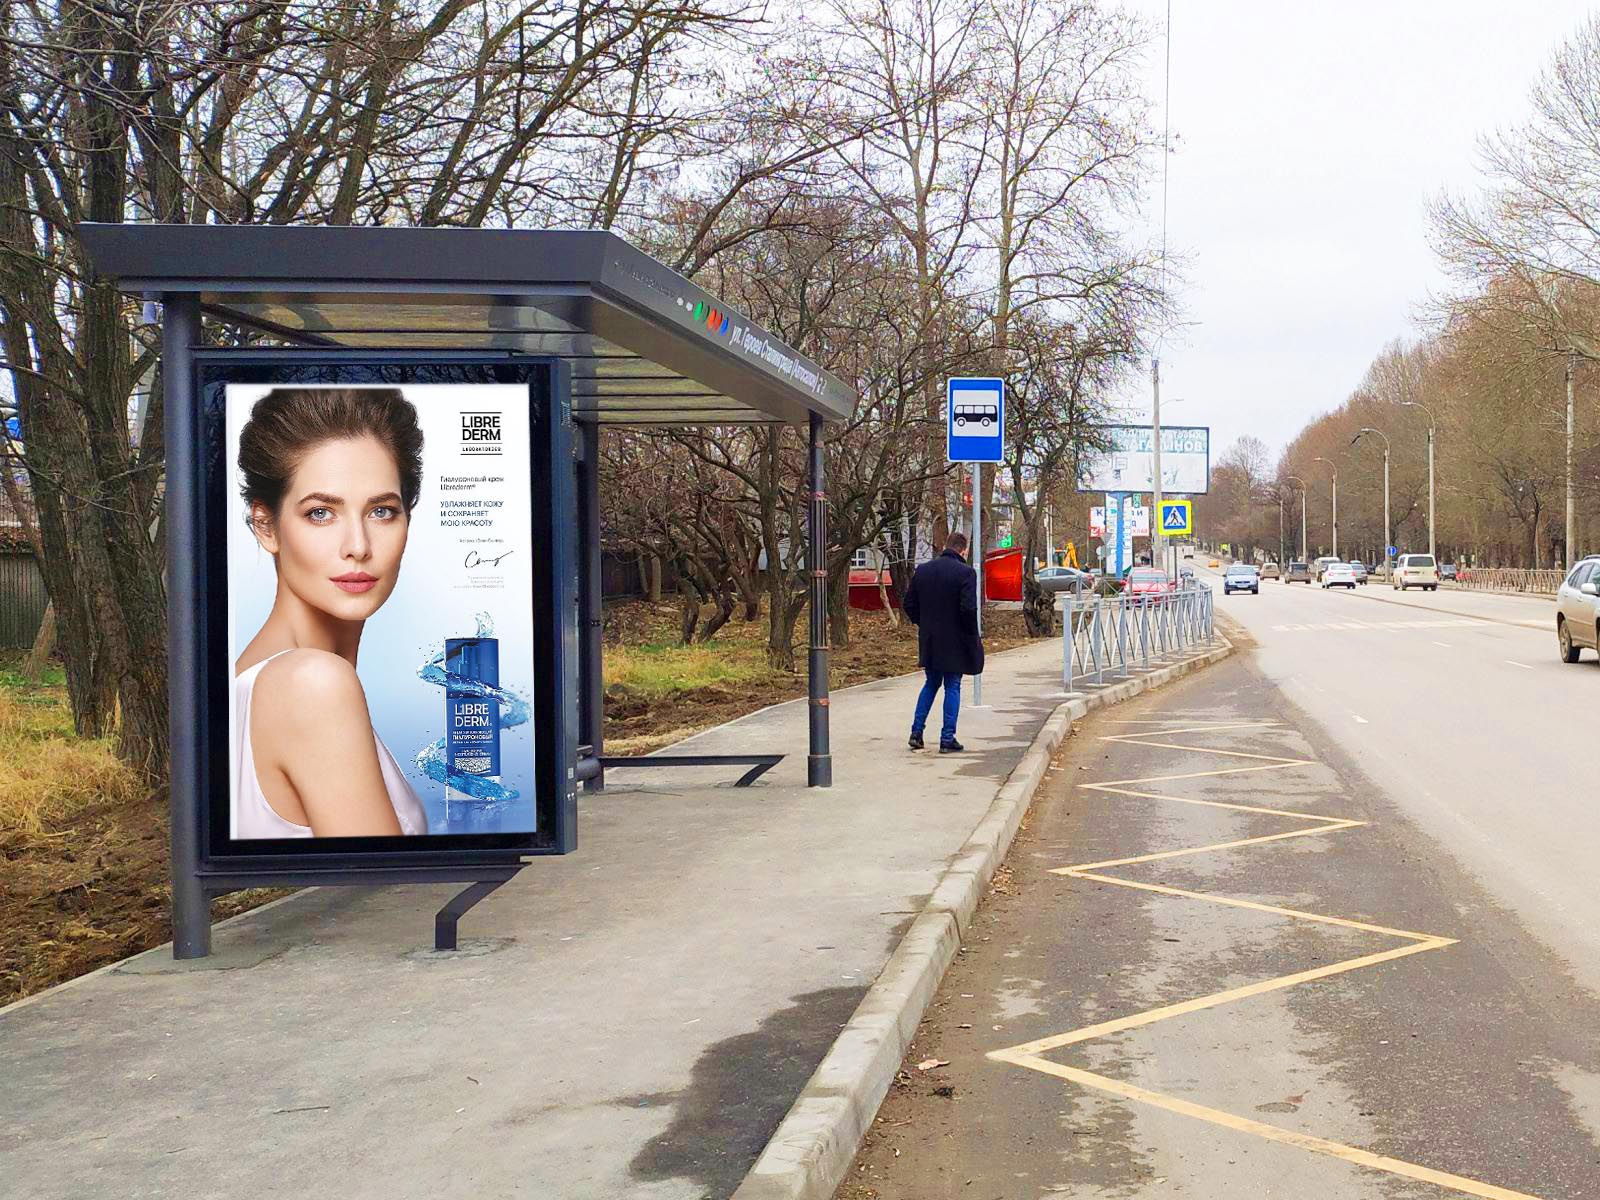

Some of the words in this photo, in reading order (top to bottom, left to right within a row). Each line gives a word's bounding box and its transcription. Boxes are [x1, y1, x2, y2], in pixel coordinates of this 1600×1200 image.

[462, 415, 501, 428] LIBRE
[462, 428, 501, 441] DERM
[440, 500, 482, 508] УВЛАЖНЯЕТ
[483, 500, 504, 508] КОЖУ
[440, 519, 461, 527] МОЮ
[461, 519, 493, 527] КРАСОТУ
[455, 703, 489, 715] LIBRE
